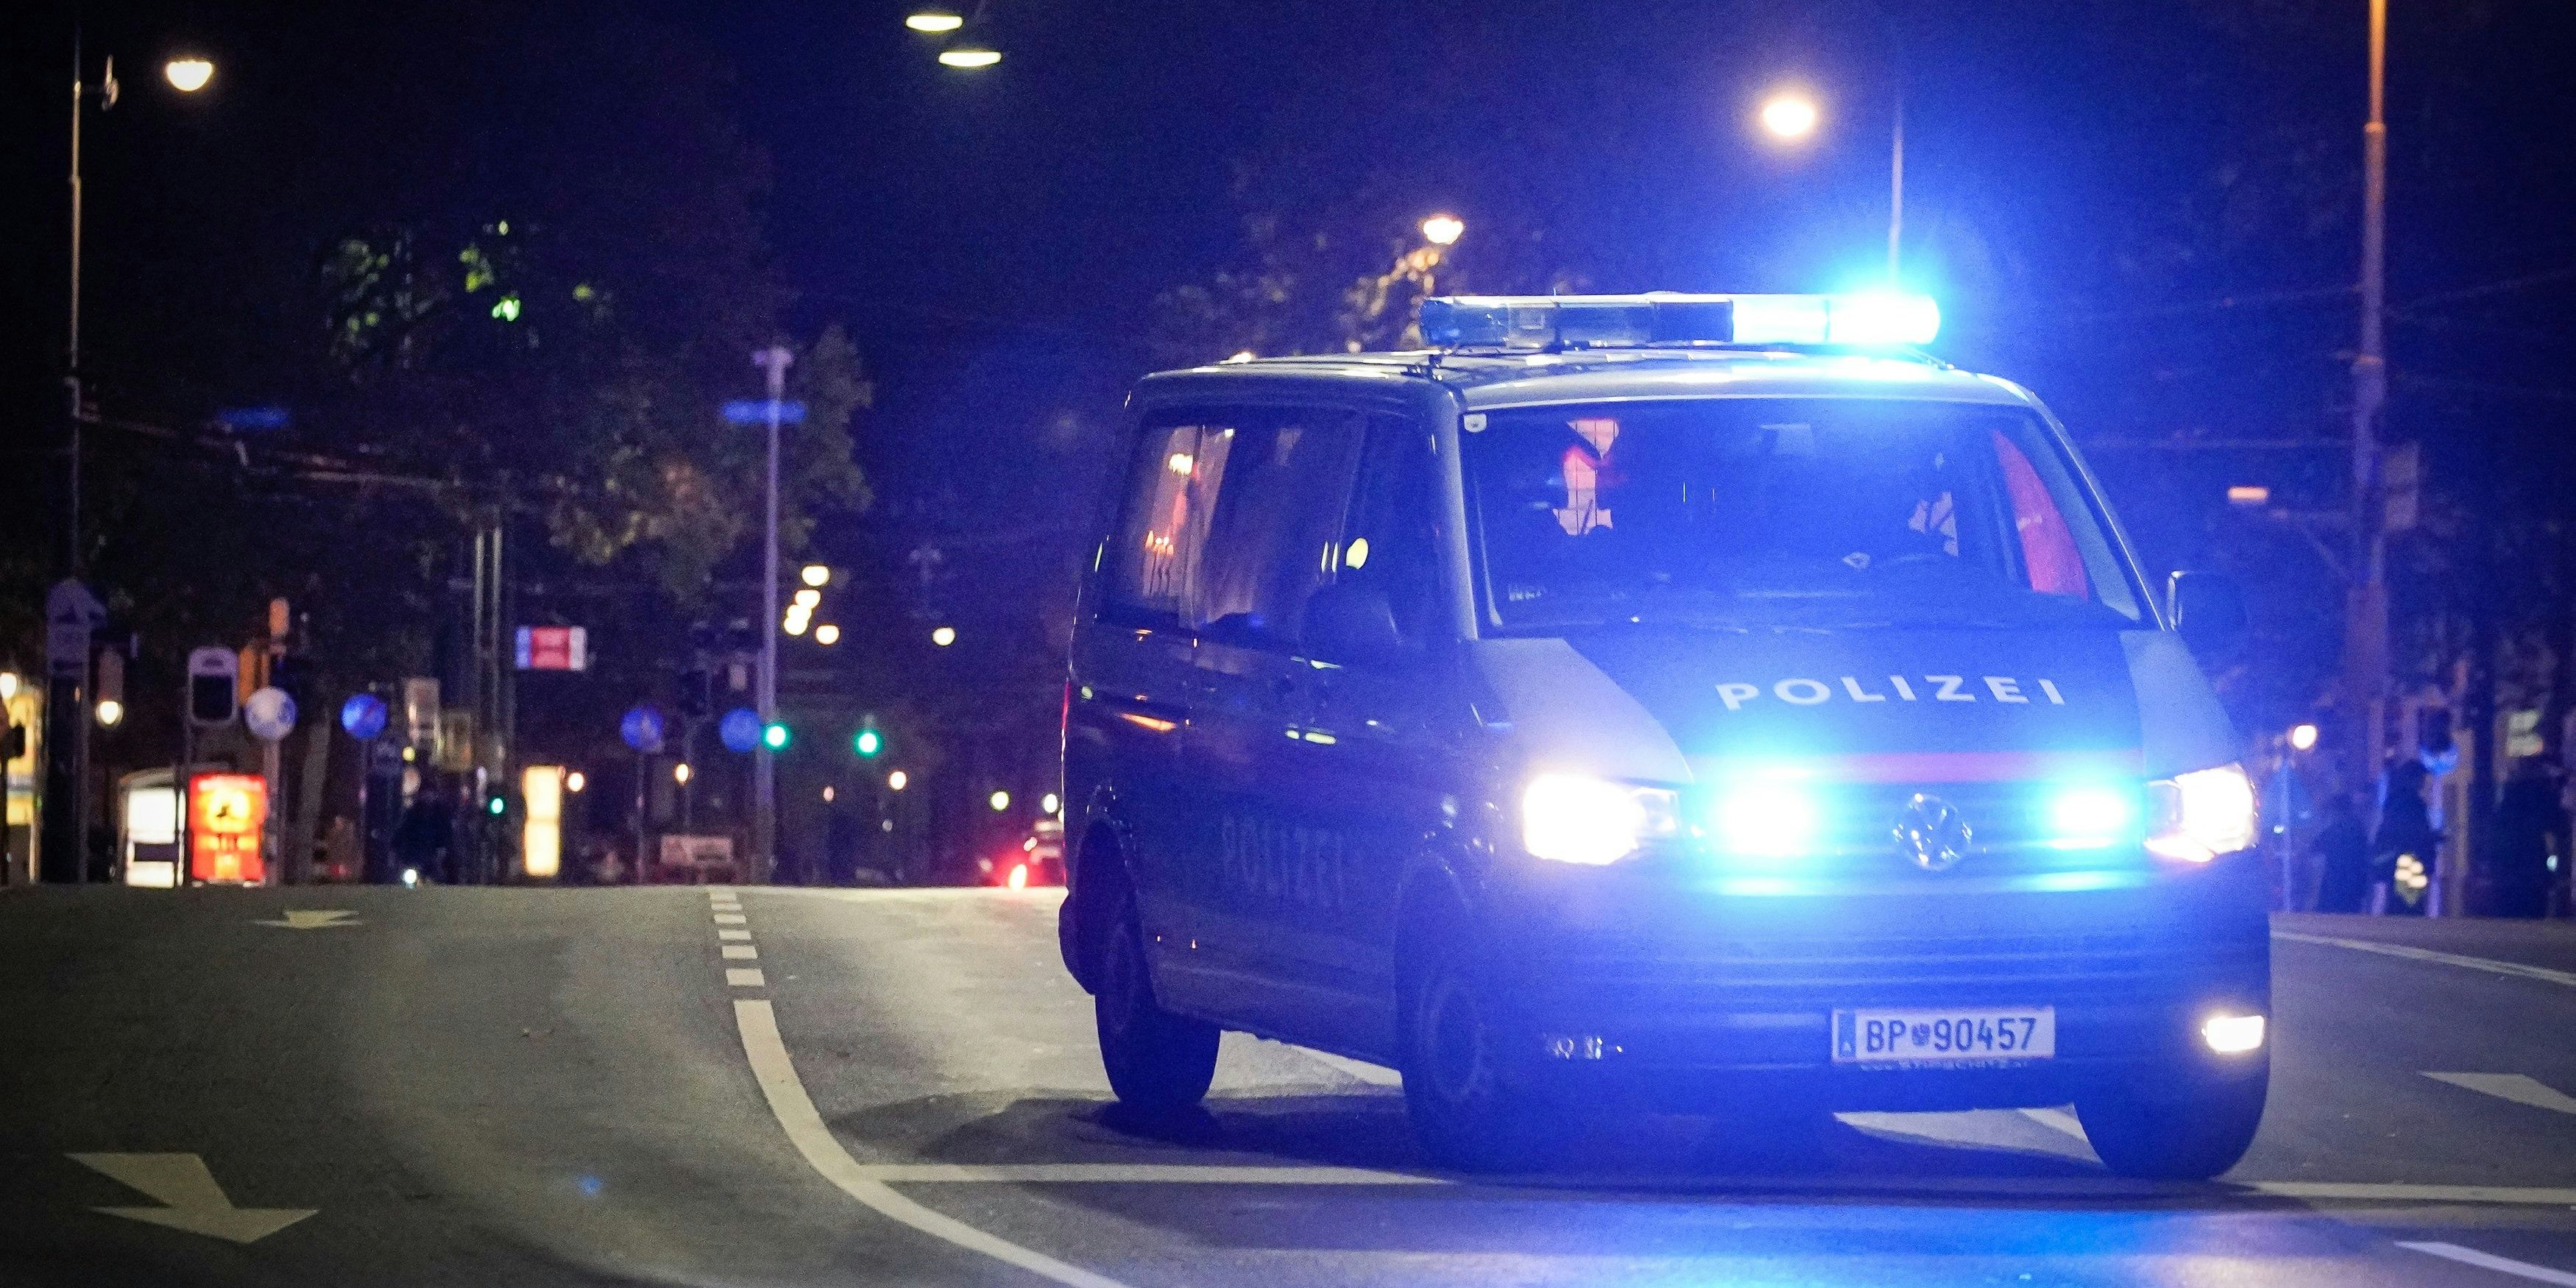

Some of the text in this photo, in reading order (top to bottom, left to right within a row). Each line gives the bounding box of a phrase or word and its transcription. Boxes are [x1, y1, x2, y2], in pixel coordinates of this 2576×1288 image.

[1716, 675, 2065, 711] POLIZEI
[1222, 813, 1345, 908] POLIZEI
[1866, 1017, 2037, 1052] BP 90457
